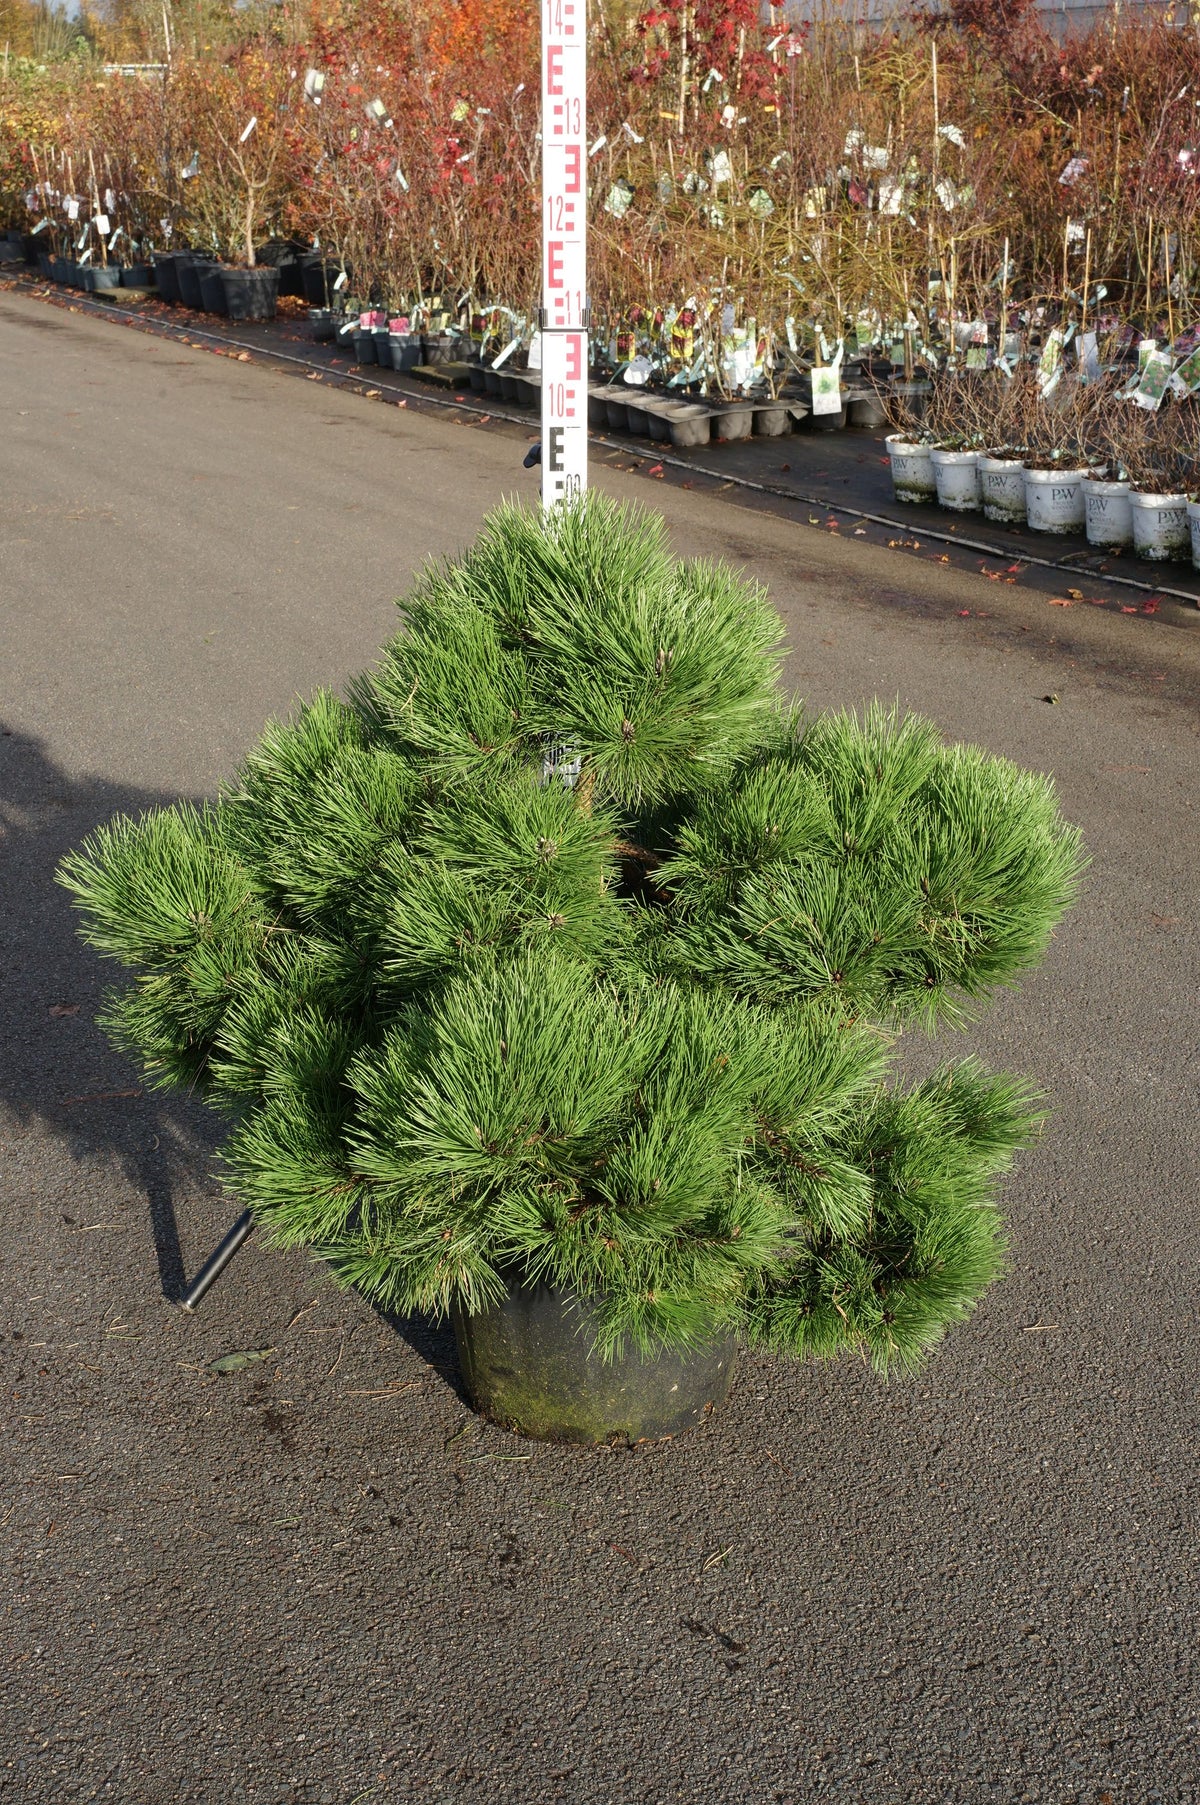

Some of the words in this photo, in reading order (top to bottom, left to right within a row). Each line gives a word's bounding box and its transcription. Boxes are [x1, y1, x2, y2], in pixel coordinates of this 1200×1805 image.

[546, 0, 563, 36] 14
[564, 97, 581, 135] 13
[547, 195, 563, 232] 12
[565, 290, 581, 325] 11
[548, 382, 564, 418] 10
[988, 475, 1008, 488] PW
[1052, 487, 1077, 501] PW
[1088, 497, 1109, 512] PW
